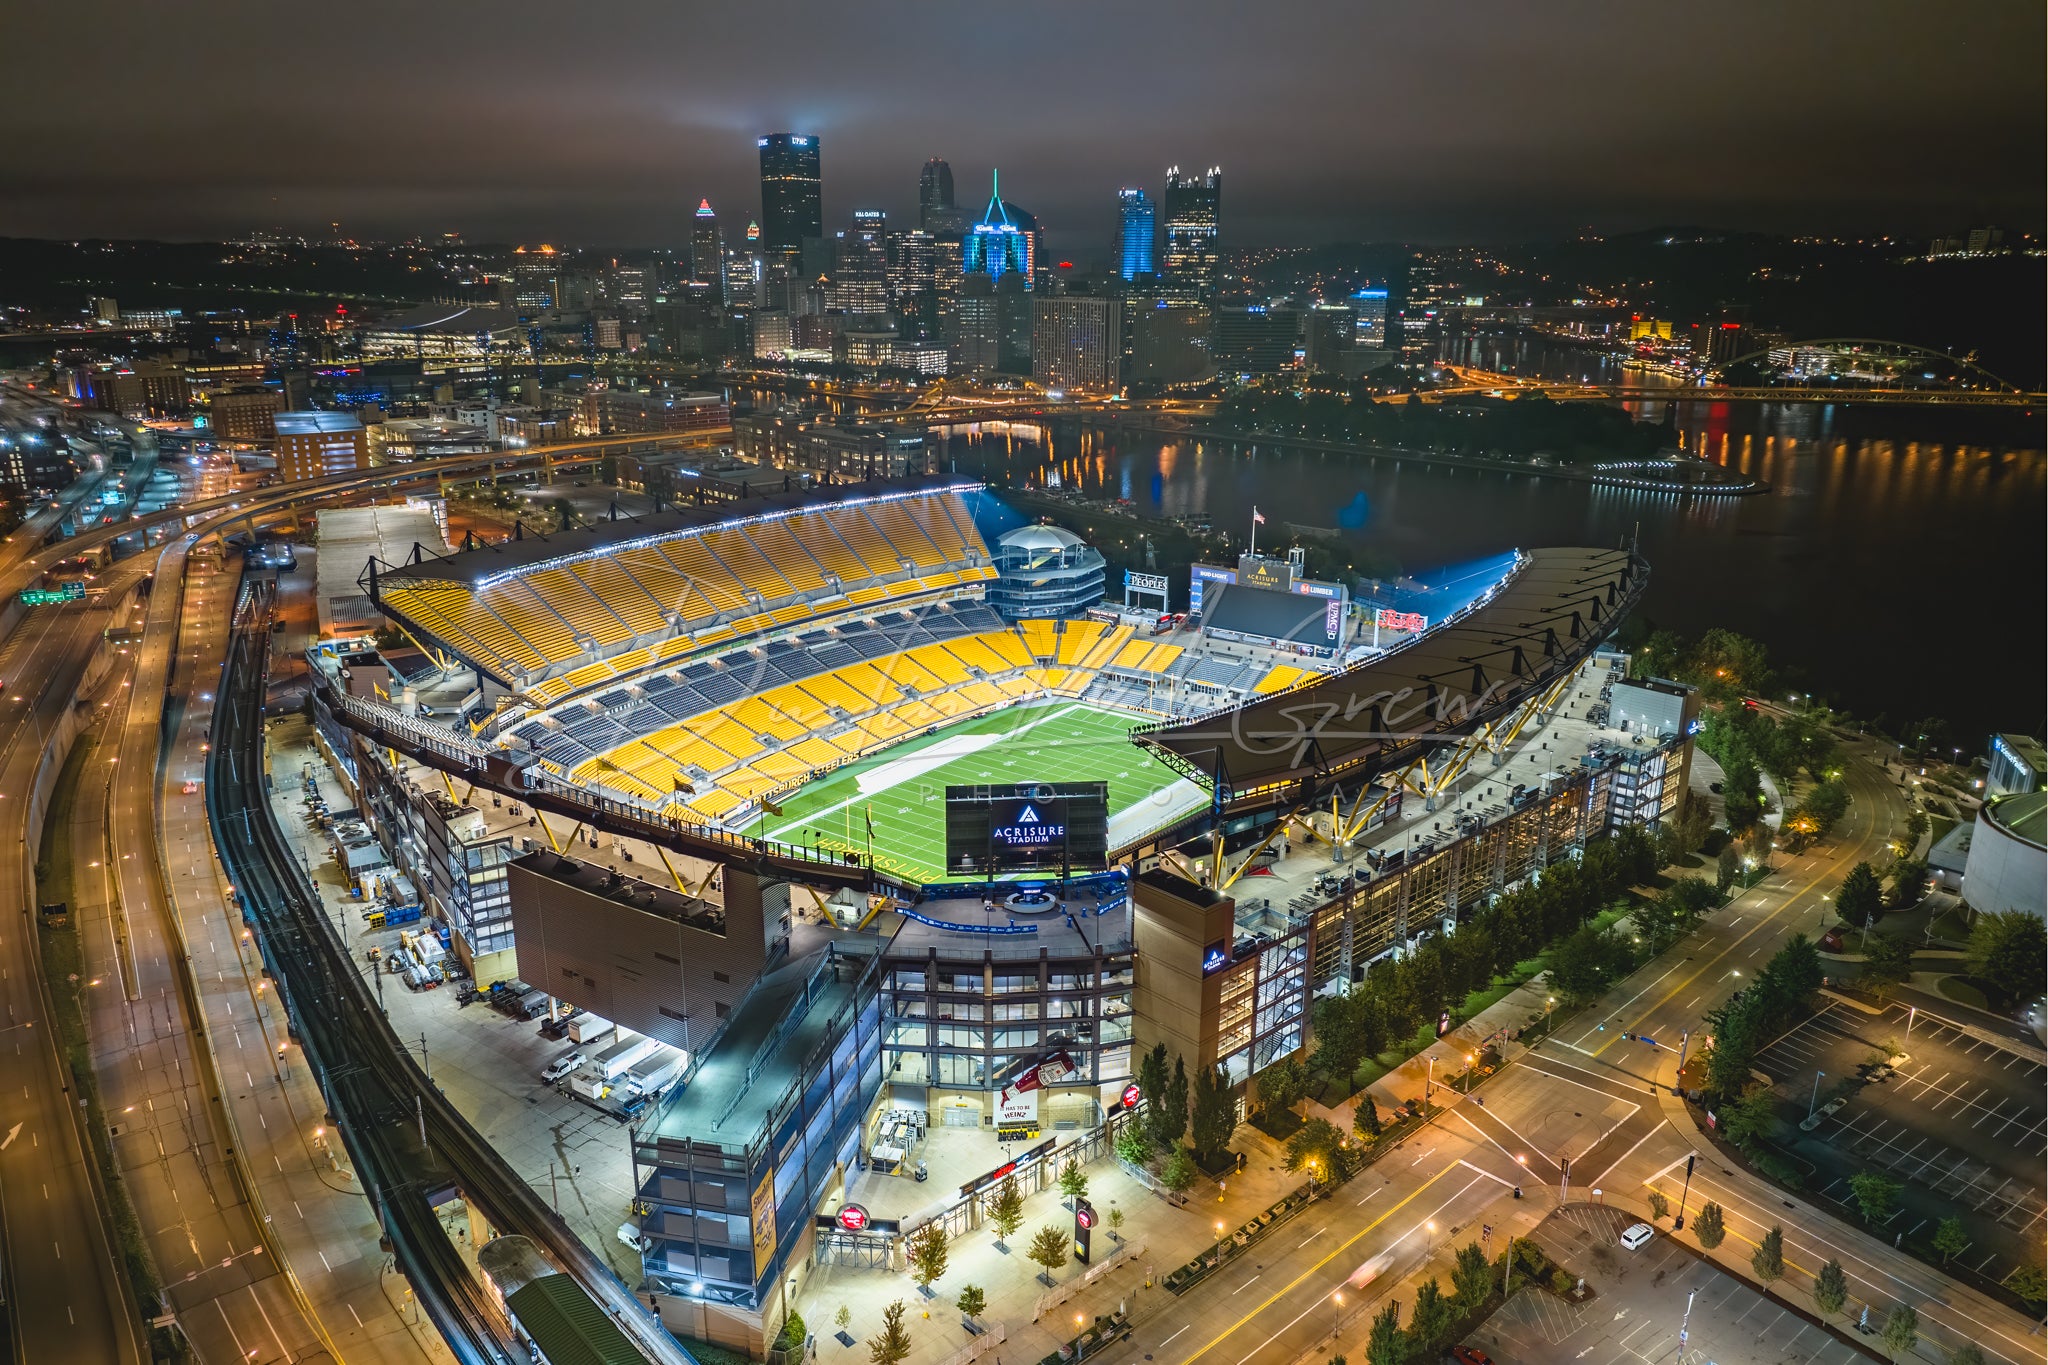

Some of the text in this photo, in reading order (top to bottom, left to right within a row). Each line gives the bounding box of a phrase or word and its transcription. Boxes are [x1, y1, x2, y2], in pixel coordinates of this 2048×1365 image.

[792, 137, 807, 146] UPMC
[1211, 572, 1227, 580] LIGHT
[1247, 574, 1279, 583] ACRISURE
[1131, 575, 1168, 590] PEOPLES
[1310, 588, 1333, 596] LUMBER
[1330, 602, 1339, 630] UPMC
[753, 751, 860, 806] PITTSBURGH STEELERS
[994, 826, 1064, 838] ACRISURE
[1008, 836, 1049, 844] STADIUM
